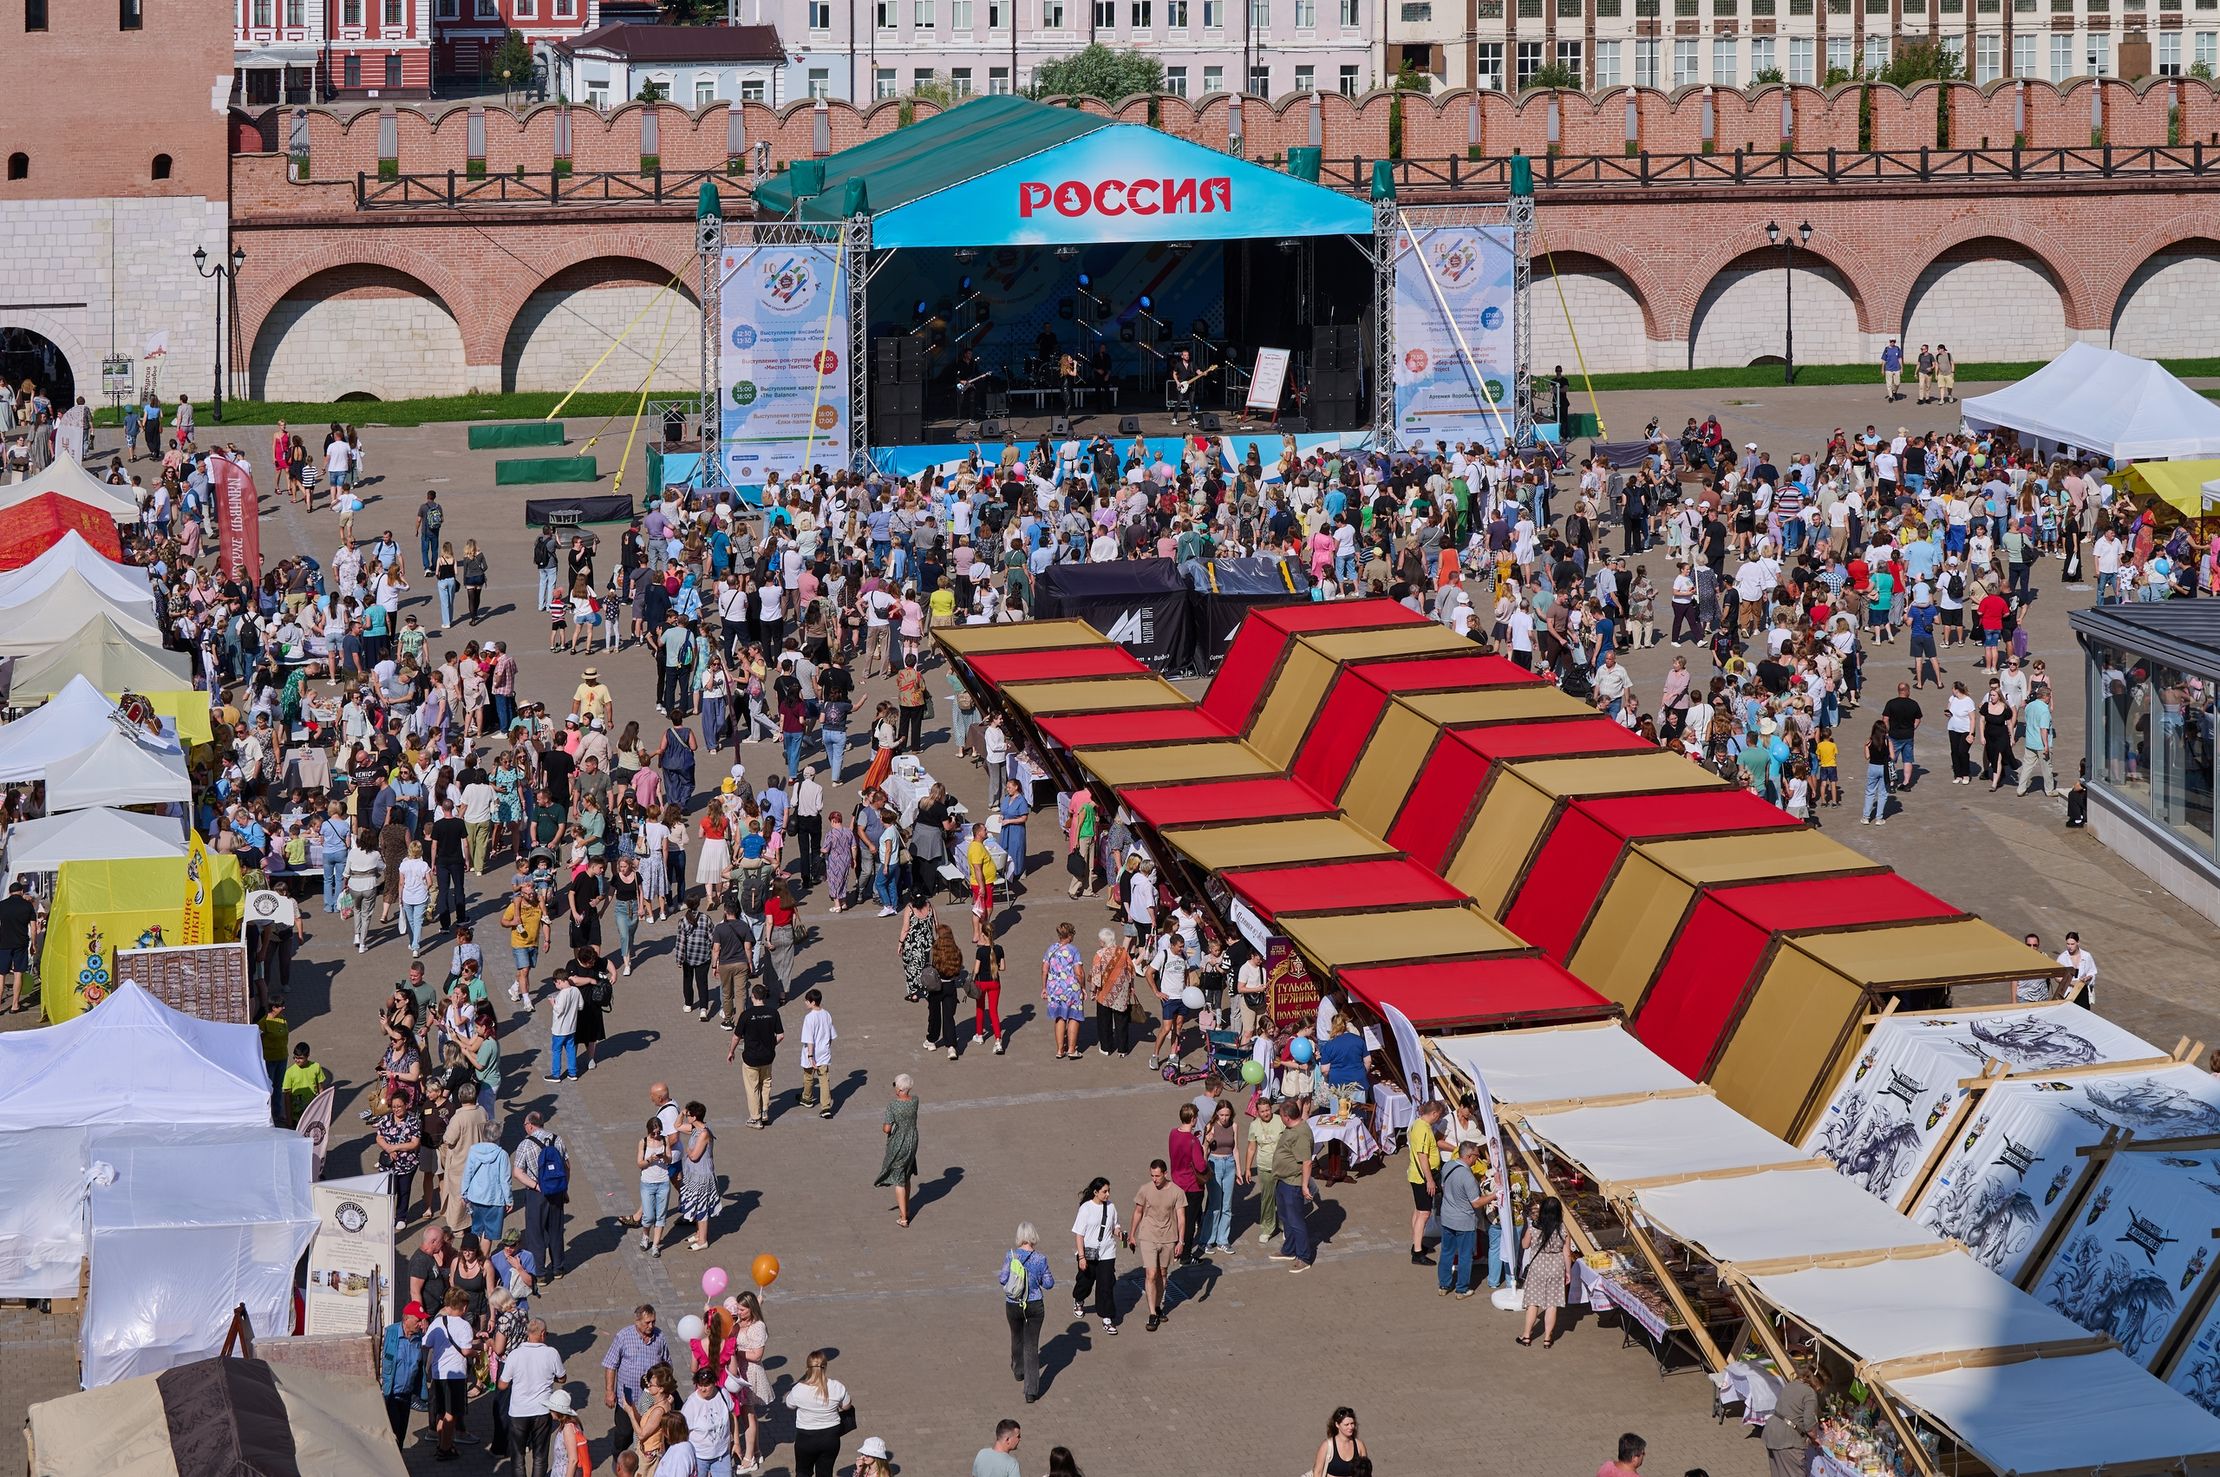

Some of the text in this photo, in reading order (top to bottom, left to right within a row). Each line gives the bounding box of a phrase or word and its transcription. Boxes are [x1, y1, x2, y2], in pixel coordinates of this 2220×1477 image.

[1019, 177, 1232, 218] РОССИЯ
[779, 357, 812, 365] рок-группы
[1277, 990, 1320, 1005] ПРЯНИКИ
[2128, 1226, 2161, 1250] КЛИНКОВ
